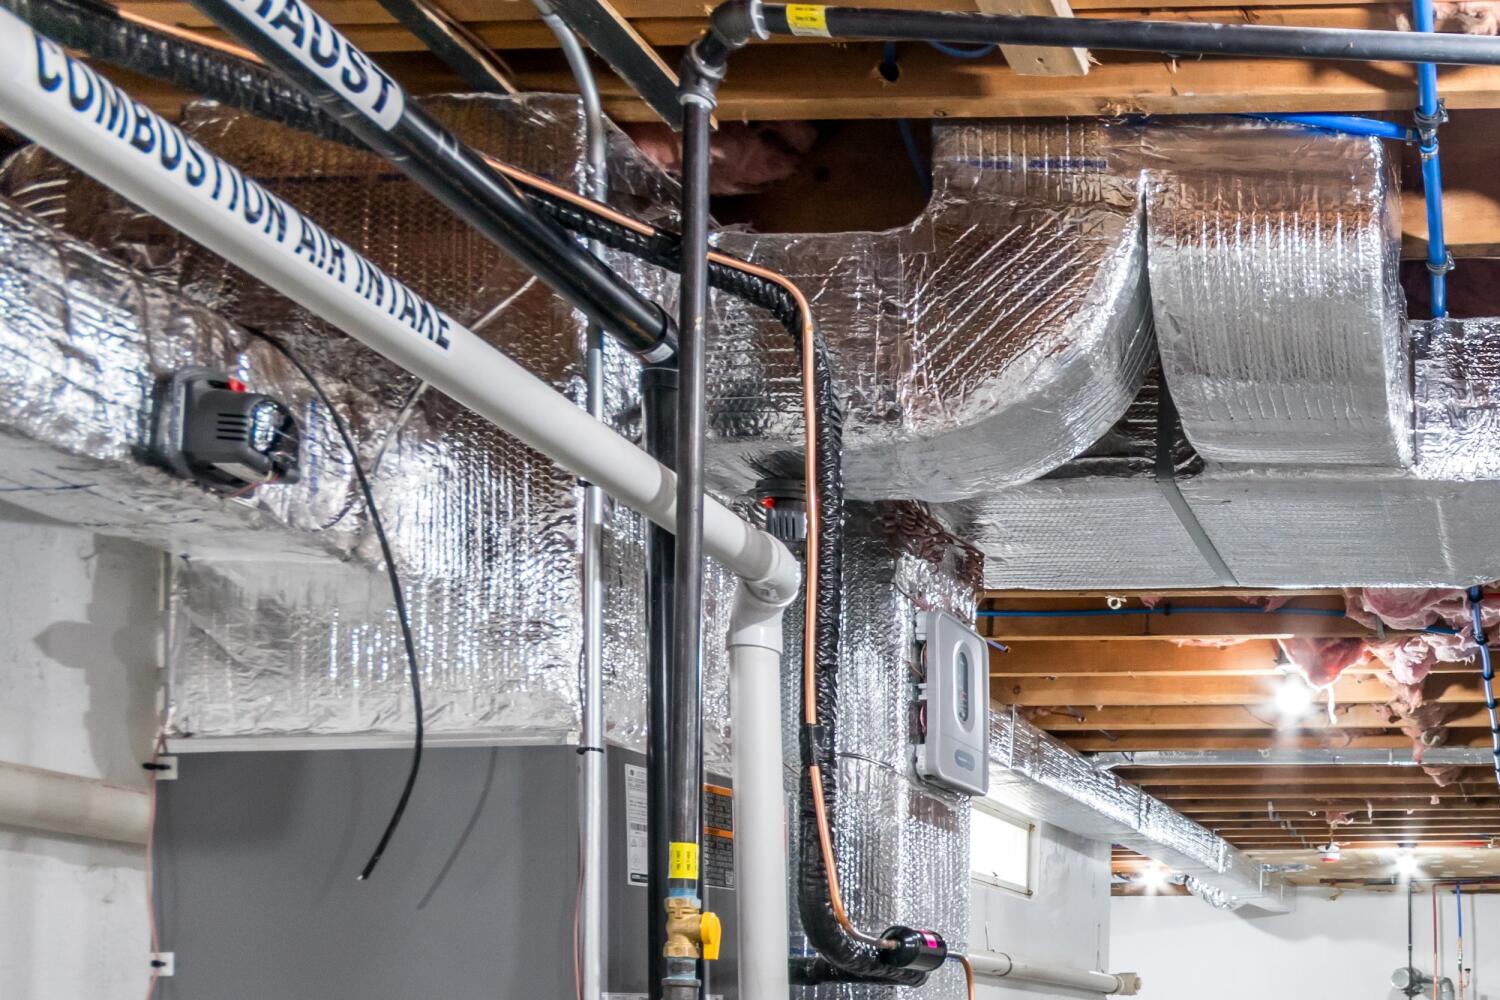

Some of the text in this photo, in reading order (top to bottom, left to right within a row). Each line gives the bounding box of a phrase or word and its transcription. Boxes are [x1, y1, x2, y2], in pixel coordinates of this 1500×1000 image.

[35, 34, 451, 351] COMBUSTION AIR INTAKE
